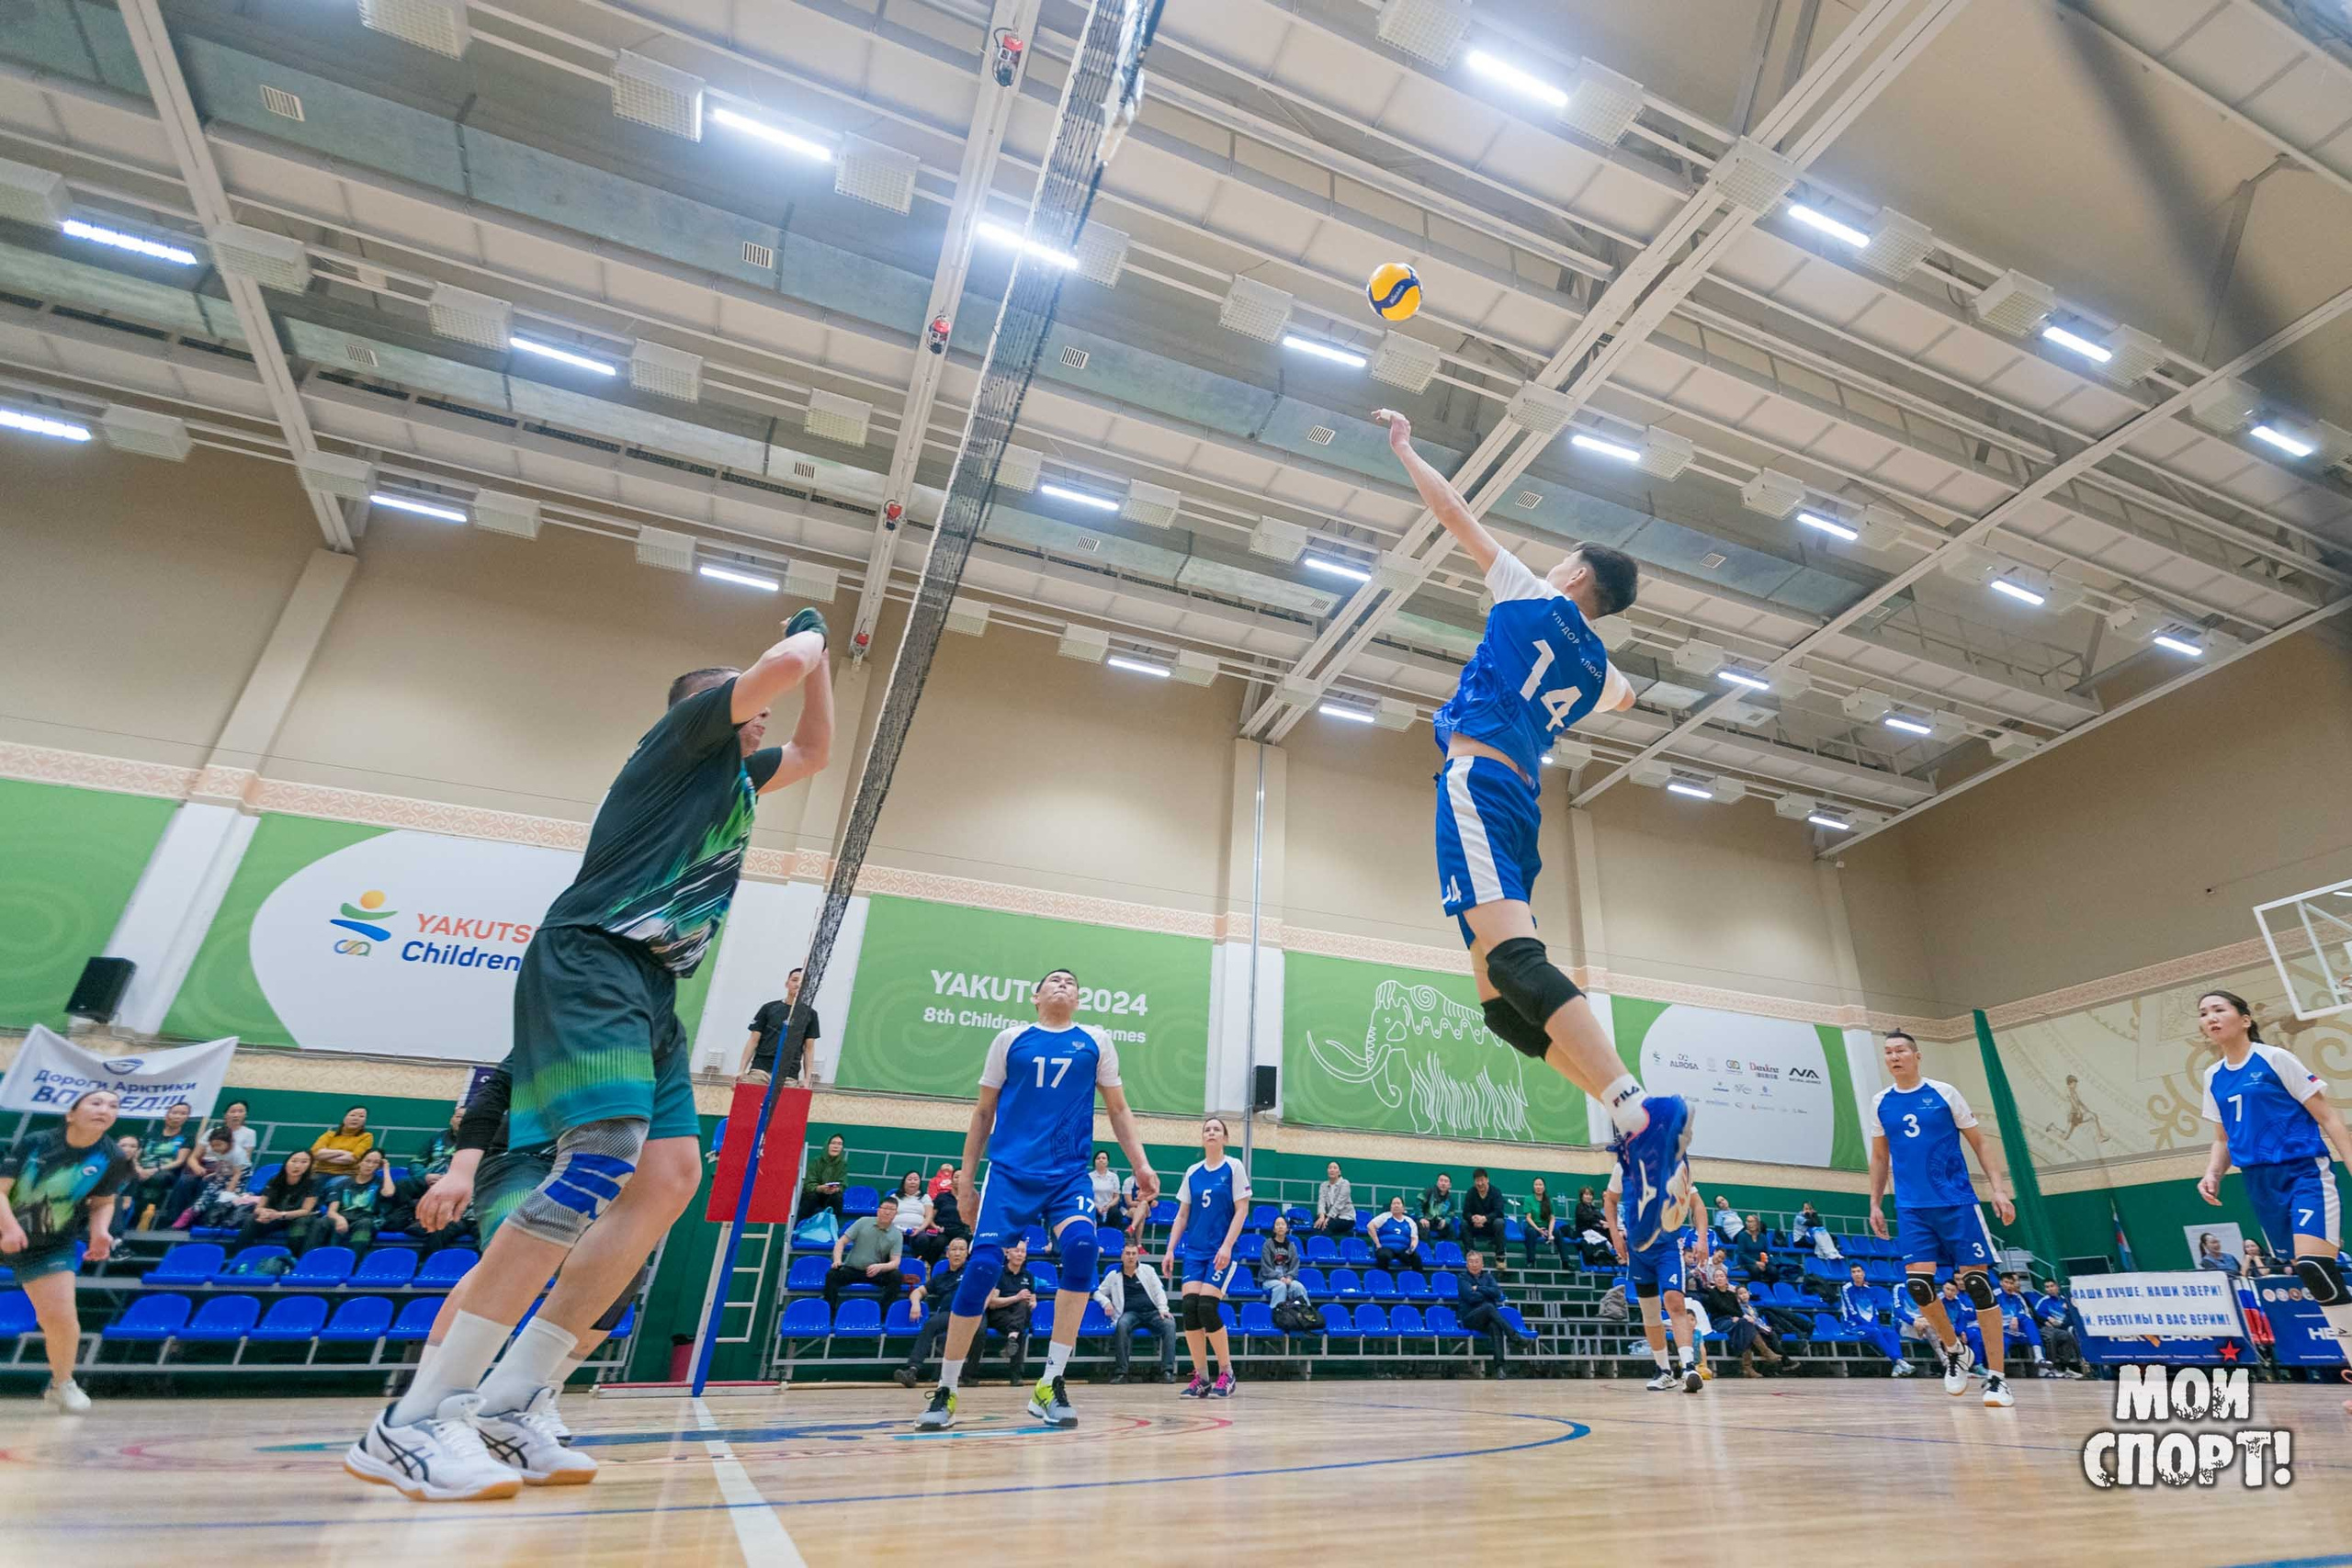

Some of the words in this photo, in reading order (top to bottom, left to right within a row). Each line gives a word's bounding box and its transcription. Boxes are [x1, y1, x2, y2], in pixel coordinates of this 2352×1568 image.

[1520, 639, 1582, 732] 14
[418, 913, 538, 944] YAKUTS
[401, 941, 522, 972] Children
[1078, 987, 1148, 1016] 2024
[923, 1007, 956, 1024] 8th
[33, 1069, 107, 1090] Дороги
[113, 1081, 197, 1094] Арктики
[1032, 1056, 1073, 1089] 17
[1612, 1085, 1640, 1108] FILA
[2227, 1094, 2243, 1122] 7
[1902, 1113, 1921, 1138] 3
[1202, 1189, 1213, 1208] 5
[2297, 1208, 2314, 1227] 7
[1972, 1242, 1985, 1258] 3
[1212, 1269, 1224, 1281] 5
[1668, 1273, 1679, 1285] 4
[2147, 1285, 2179, 1297] НАШИ
[2182, 1285, 2223, 1297] ЗВЕРИ!
[2155, 1314, 2164, 1325] В
[2165, 1314, 2187, 1325] ВАС
[2189, 1314, 2231, 1325] ВЕРИМ!
